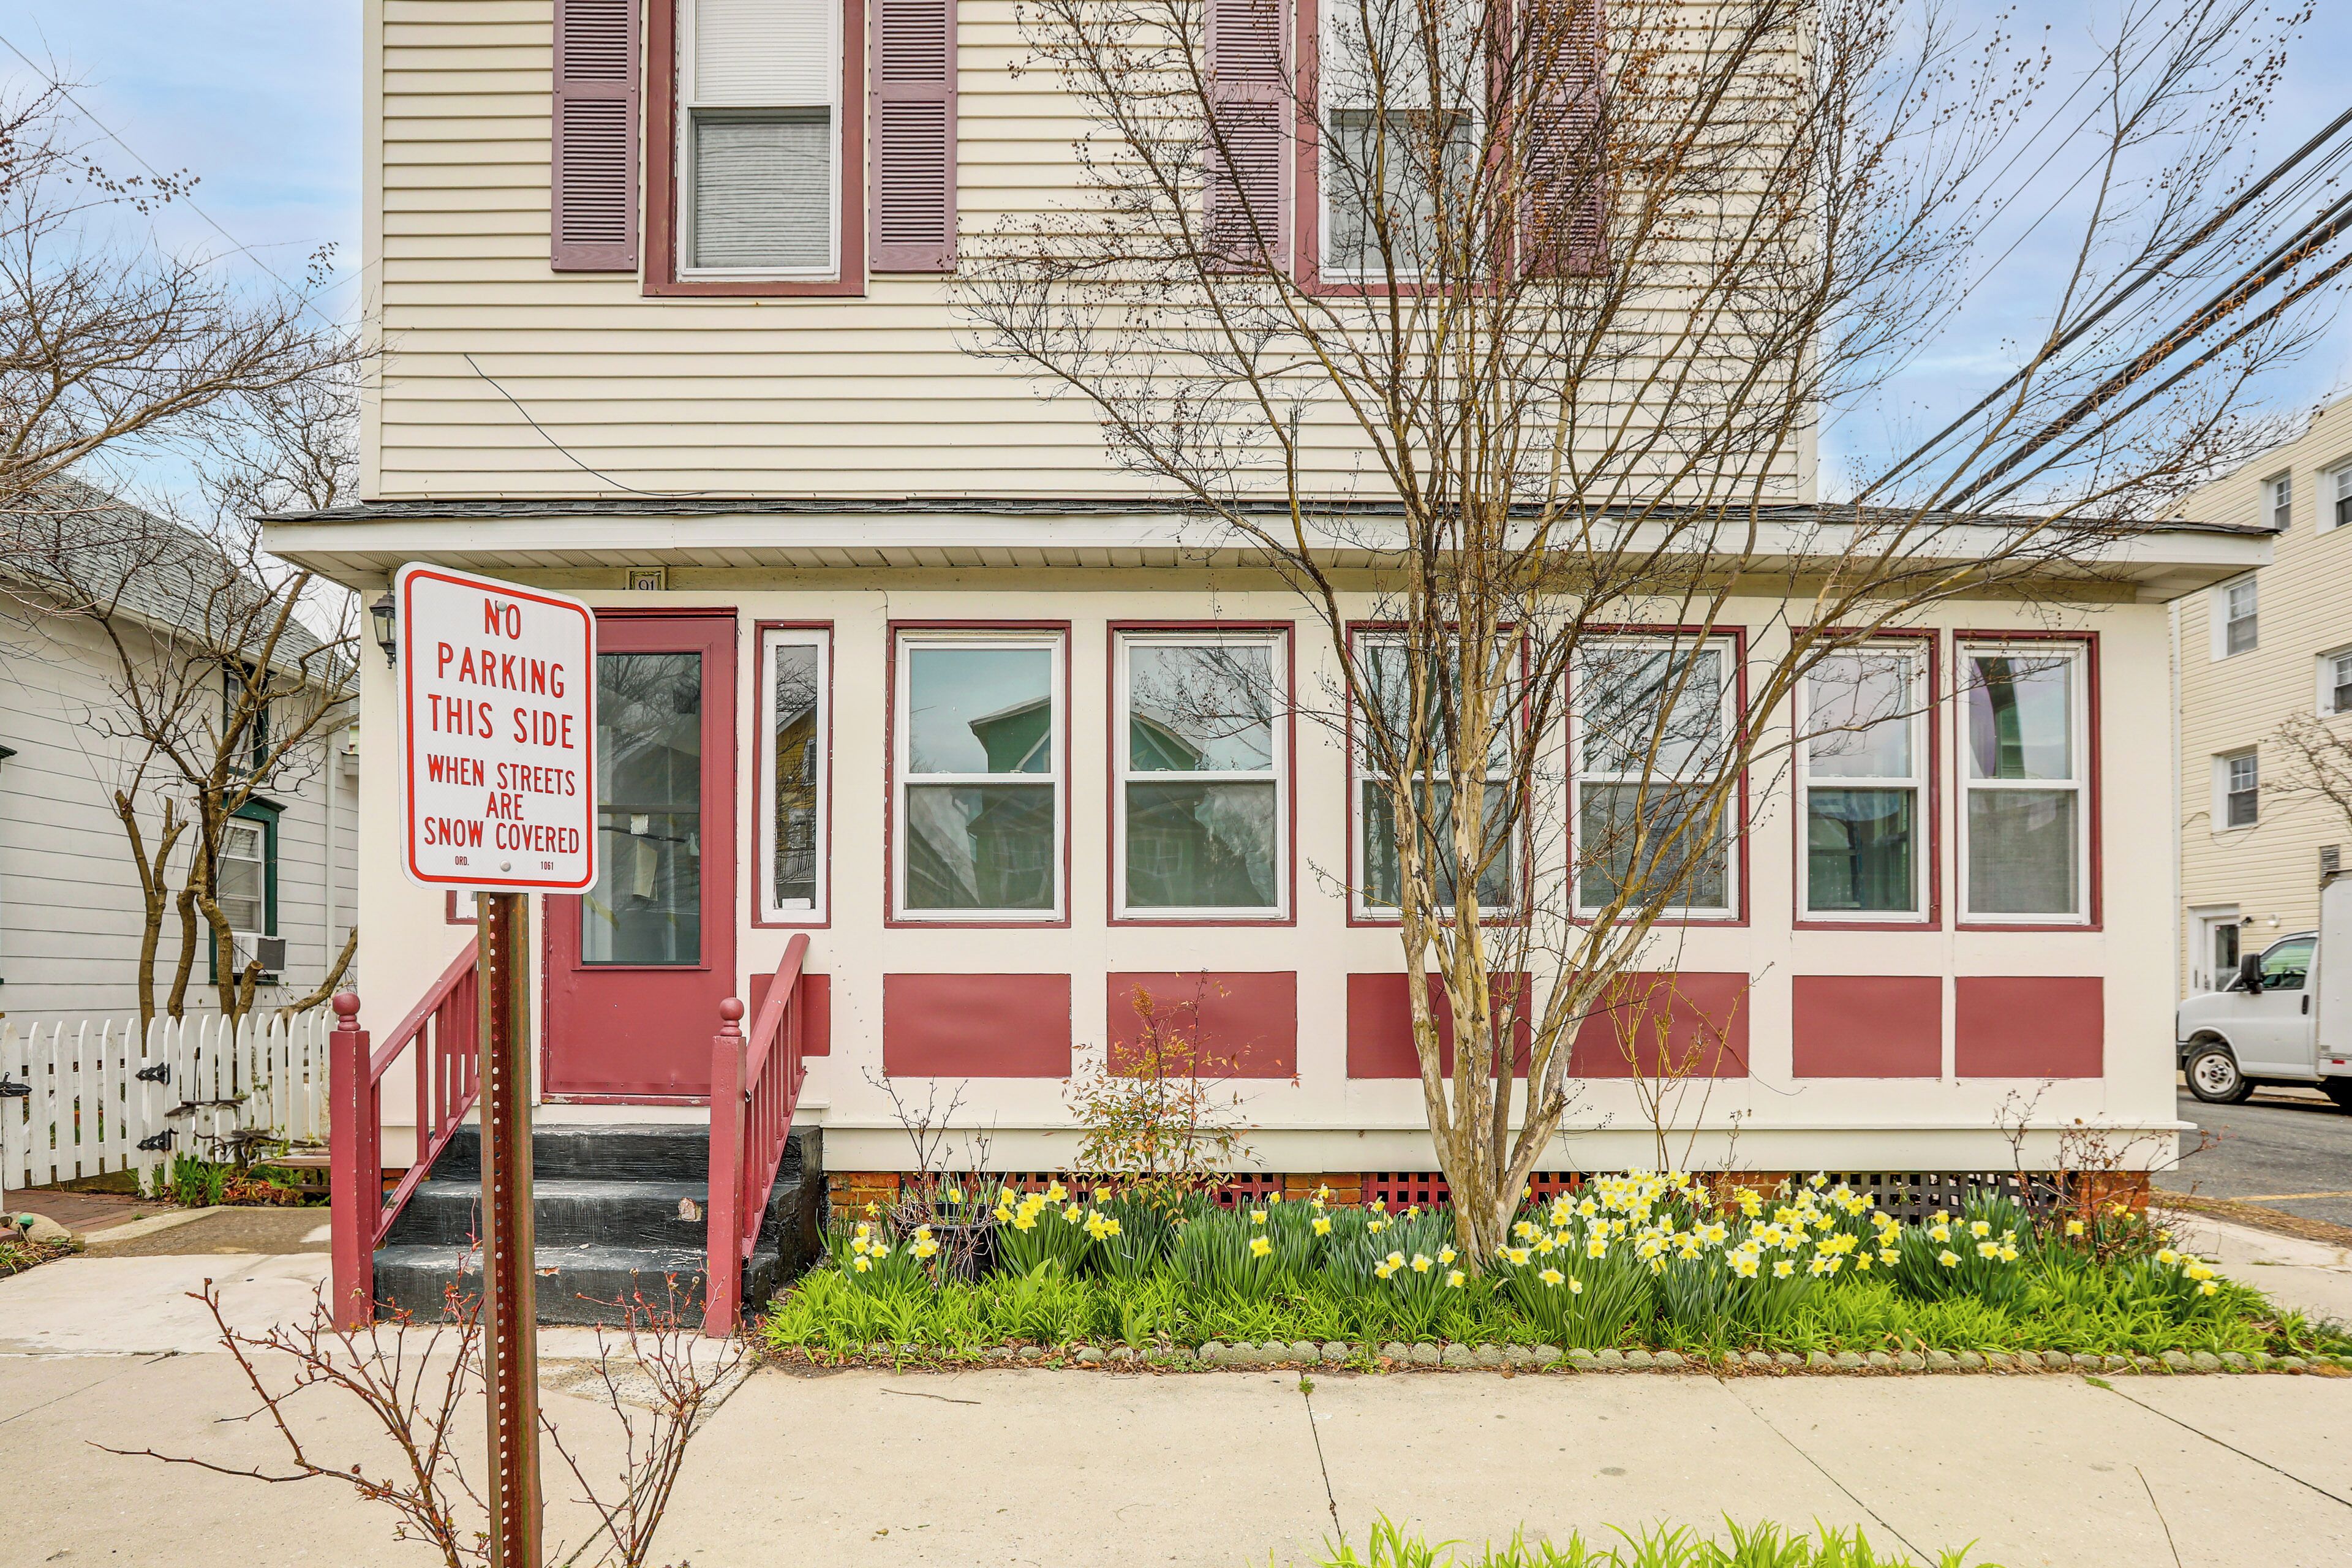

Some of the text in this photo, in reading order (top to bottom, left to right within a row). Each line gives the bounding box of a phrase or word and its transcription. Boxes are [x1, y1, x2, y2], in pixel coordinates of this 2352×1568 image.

[484, 598, 521, 640] NO
[438, 641, 564, 698] PARKING
[428, 693, 574, 749] THIS SIDE
[428, 753, 575, 796] WHEN STREETS
[486, 791, 524, 821] ARE
[424, 816, 579, 854] SNOW COVERED
[454, 856, 554, 870] ORD. 1061
